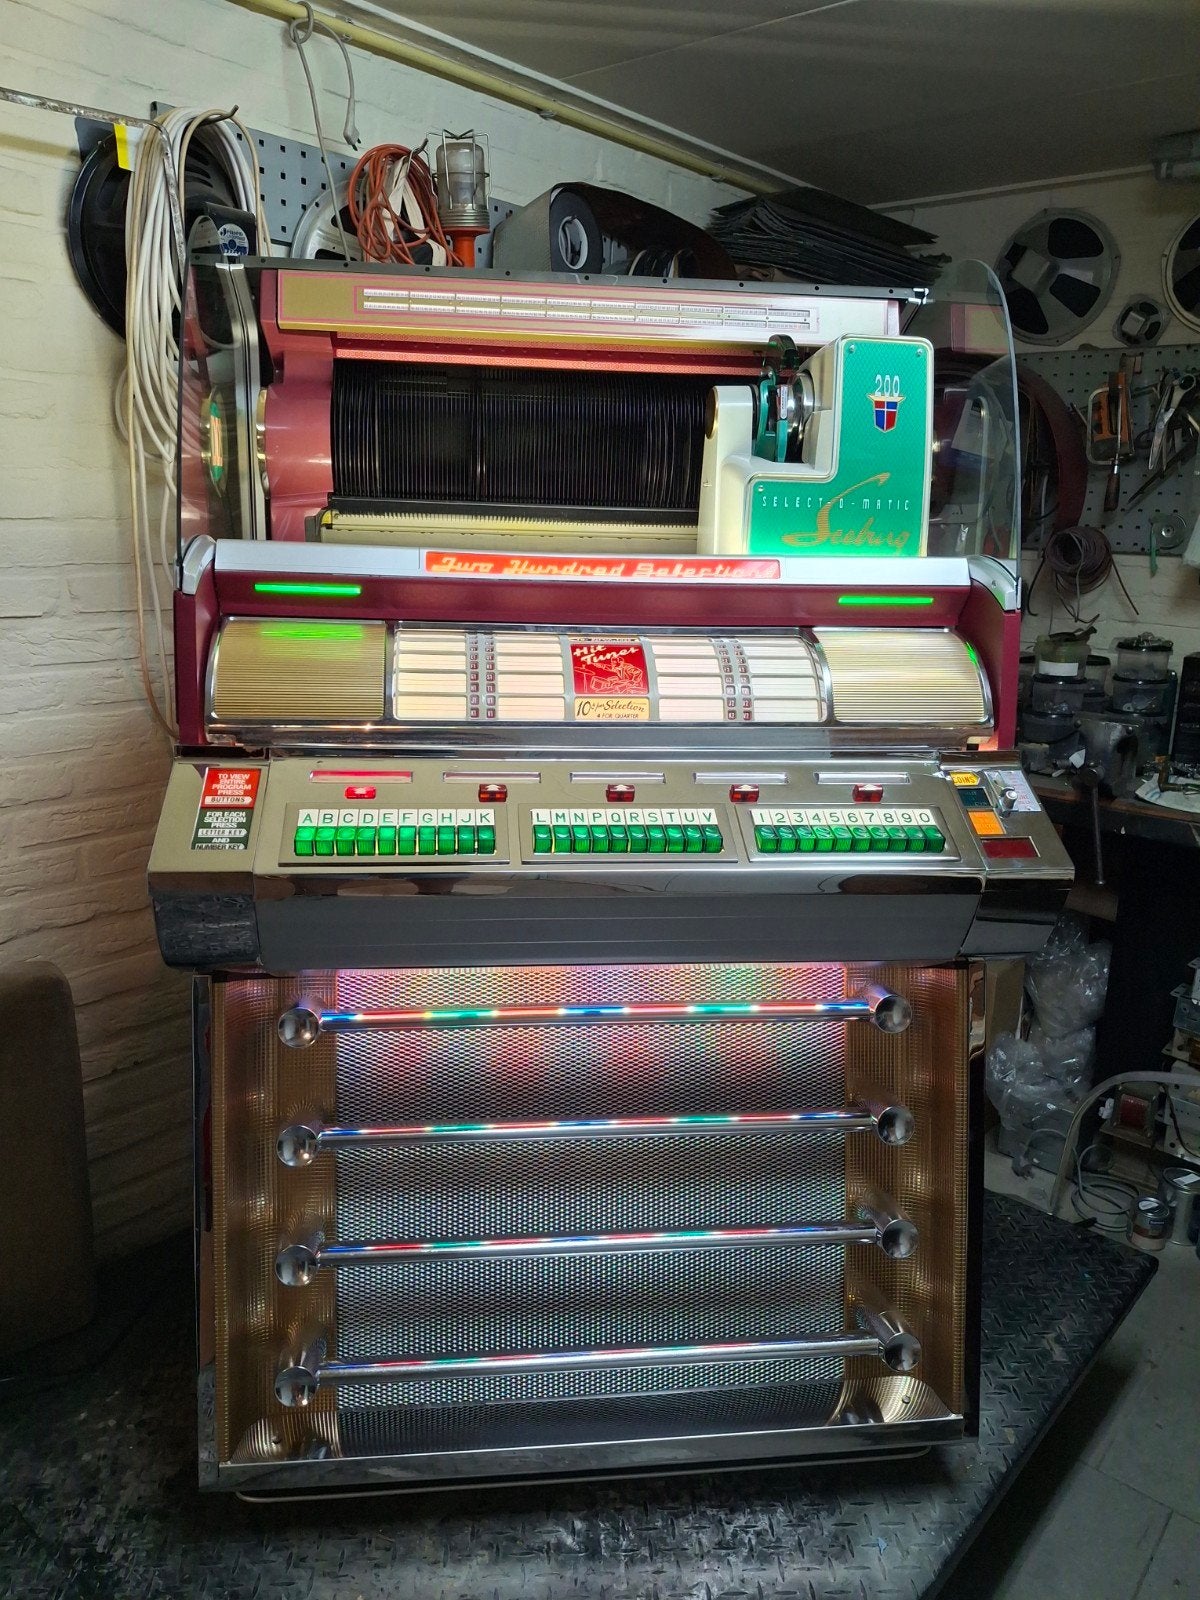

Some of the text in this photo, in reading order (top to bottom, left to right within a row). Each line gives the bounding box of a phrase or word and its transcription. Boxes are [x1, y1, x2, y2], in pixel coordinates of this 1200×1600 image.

[875, 374, 900, 397] 200
[781, 472, 911, 557] Seeburg
[502, 559, 626, 577] Hundred
[573, 645, 607, 657] Hit
[604, 699, 645, 712] Selection
[951, 776, 976, 784] COINS
[302, 813, 490, 823] A B C D E F G H J K
[536, 813, 712, 823] L M N P Q R S T U V
[774, 813, 786, 823] 2
[794, 813, 804, 823] 3
[812, 813, 822, 823] 4
[829, 813, 840, 823] 5
[847, 813, 858, 823] 6
[864, 813, 875, 823] 7
[883, 813, 894, 823] 8
[901, 813, 913, 823] 9
[919, 813, 931, 823] 0
